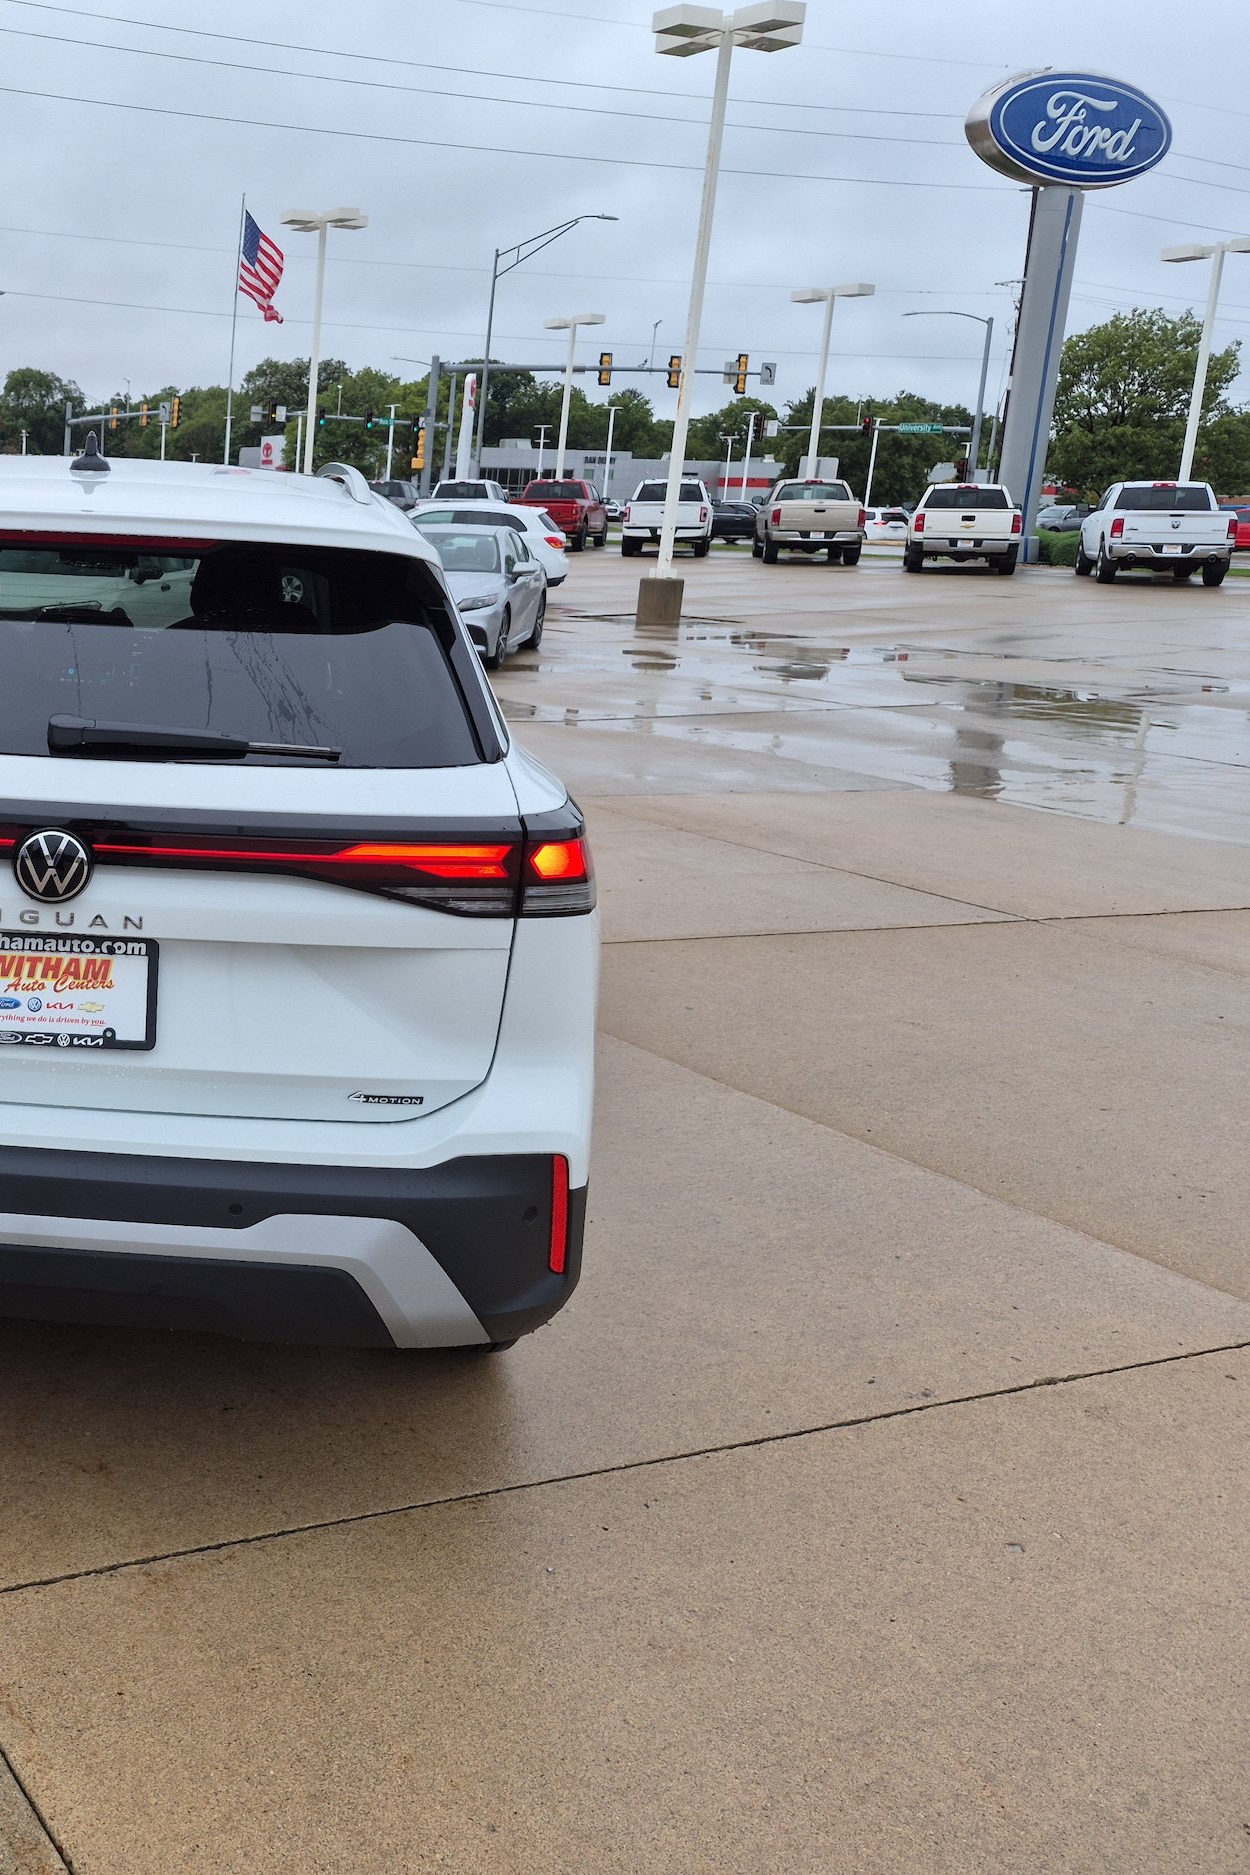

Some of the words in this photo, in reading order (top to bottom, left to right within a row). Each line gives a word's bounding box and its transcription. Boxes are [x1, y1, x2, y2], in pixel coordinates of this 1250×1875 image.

[1031, 90, 1142, 162] Ford
[900, 424, 931, 432] University
[3, 976, 47, 993] Auto
[53, 974, 115, 993] Centers
[56, 1016, 79, 1024] driven
[81, 1017, 90, 1026] by
[347, 1090, 422, 1105] 4MOTION
